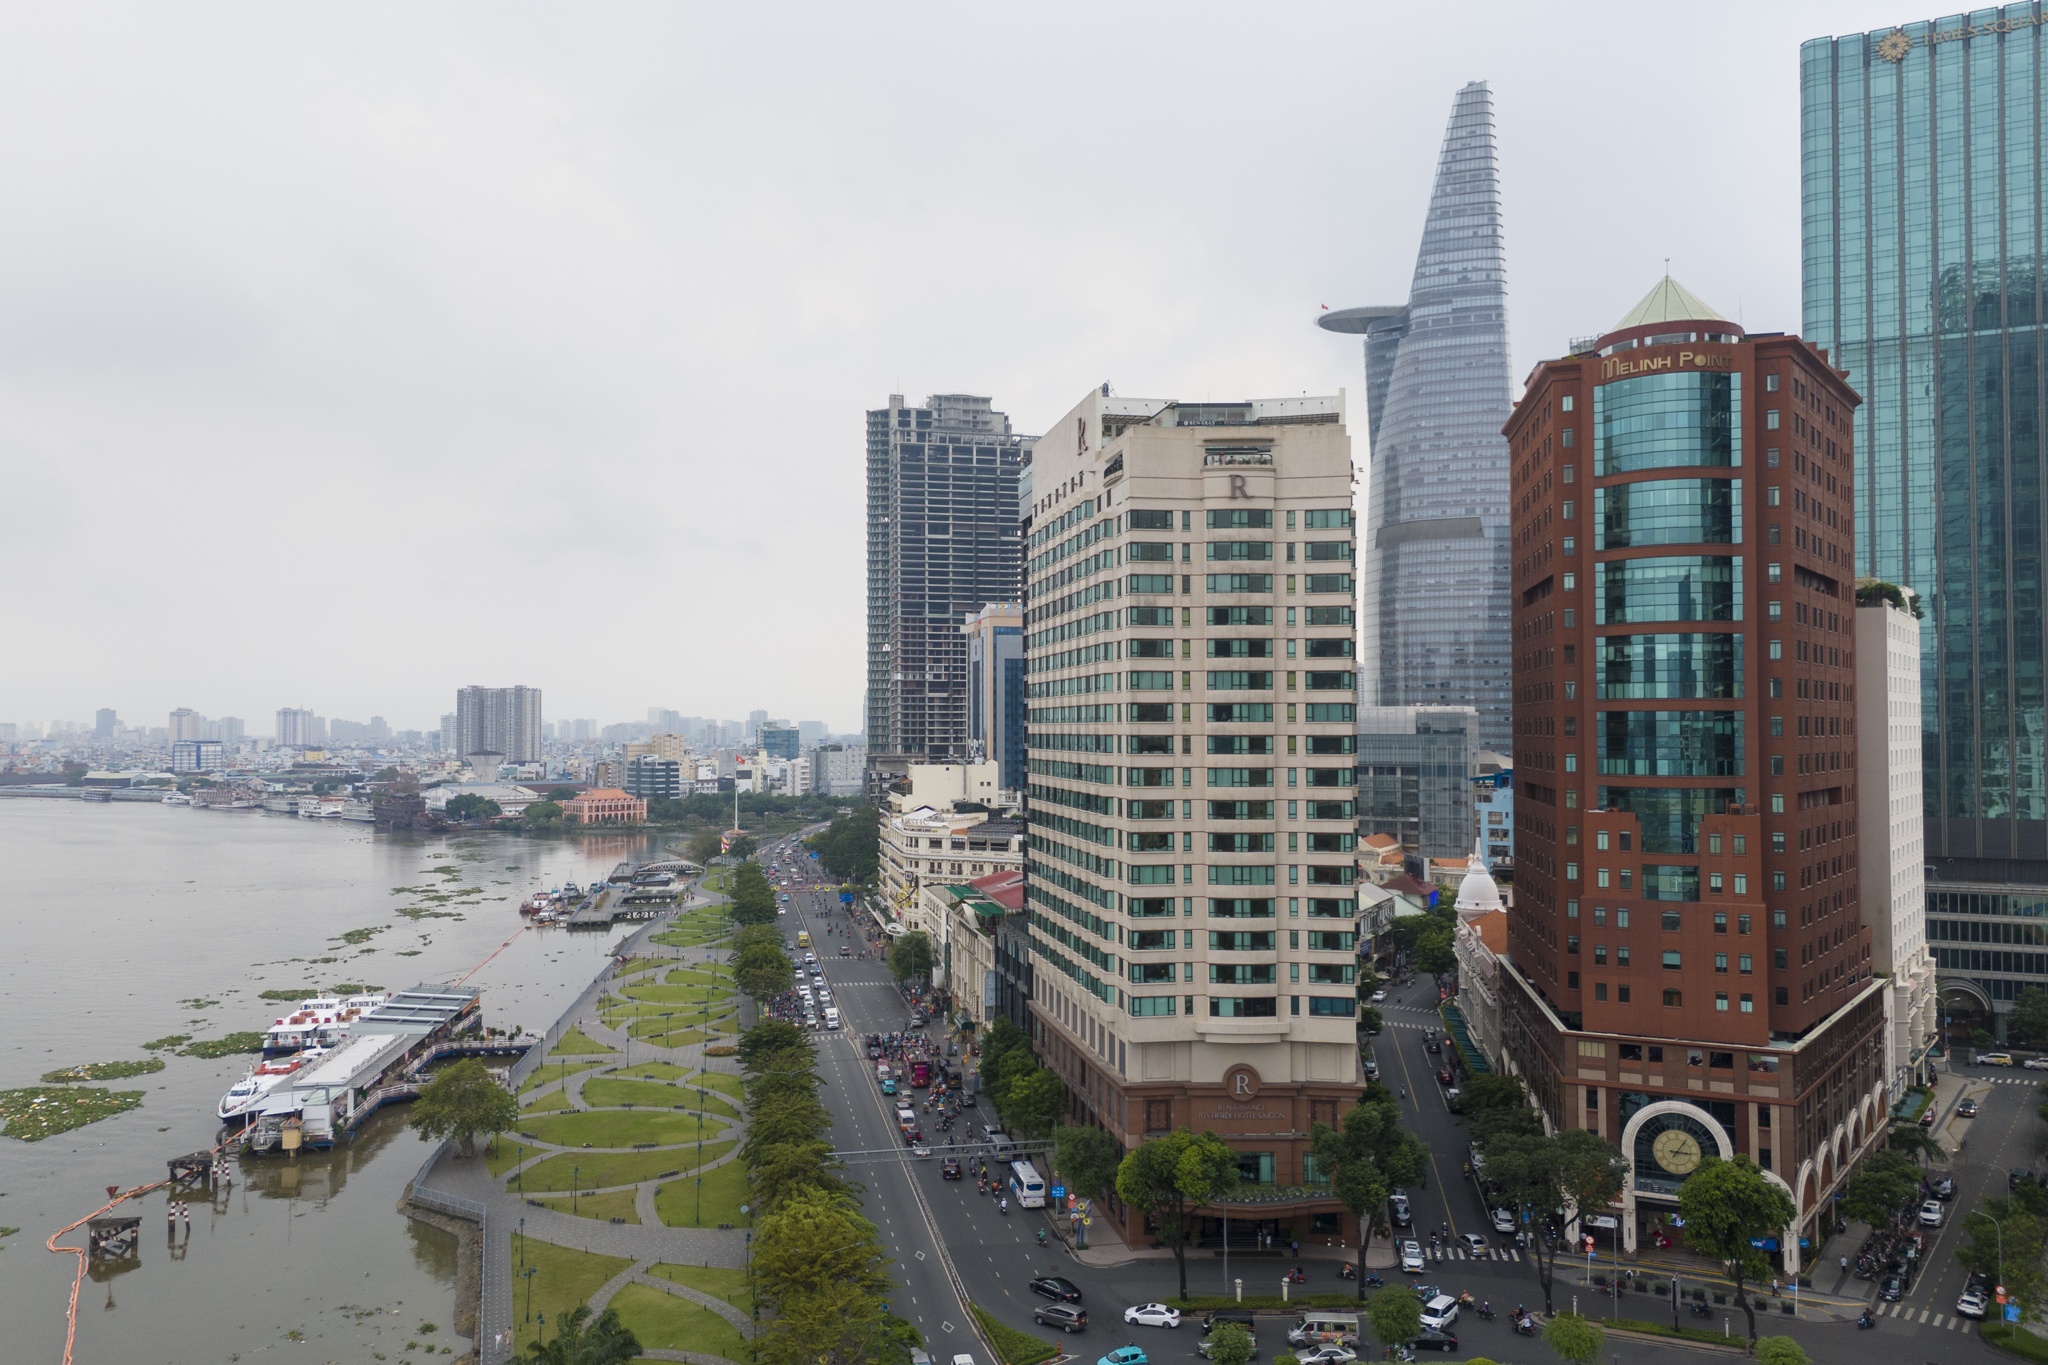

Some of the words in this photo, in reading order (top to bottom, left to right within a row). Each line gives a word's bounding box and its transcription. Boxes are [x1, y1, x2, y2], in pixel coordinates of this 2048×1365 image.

[1922, 26, 1978, 45] TIMES
[1601, 357, 1671, 380] MELINH
[1679, 352, 1732, 368] POINT
[1077, 416, 1089, 456] R
[1229, 474, 1254, 499] R
[1234, 1074, 1254, 1095] R
[1198, 1111, 1232, 1119] RIVERSIDE
[1234, 1111, 1255, 1119] HOTEL
[1258, 1111, 1285, 1119] SAIGON
[1217, 1103, 1266, 1111] RENAISSANCE
